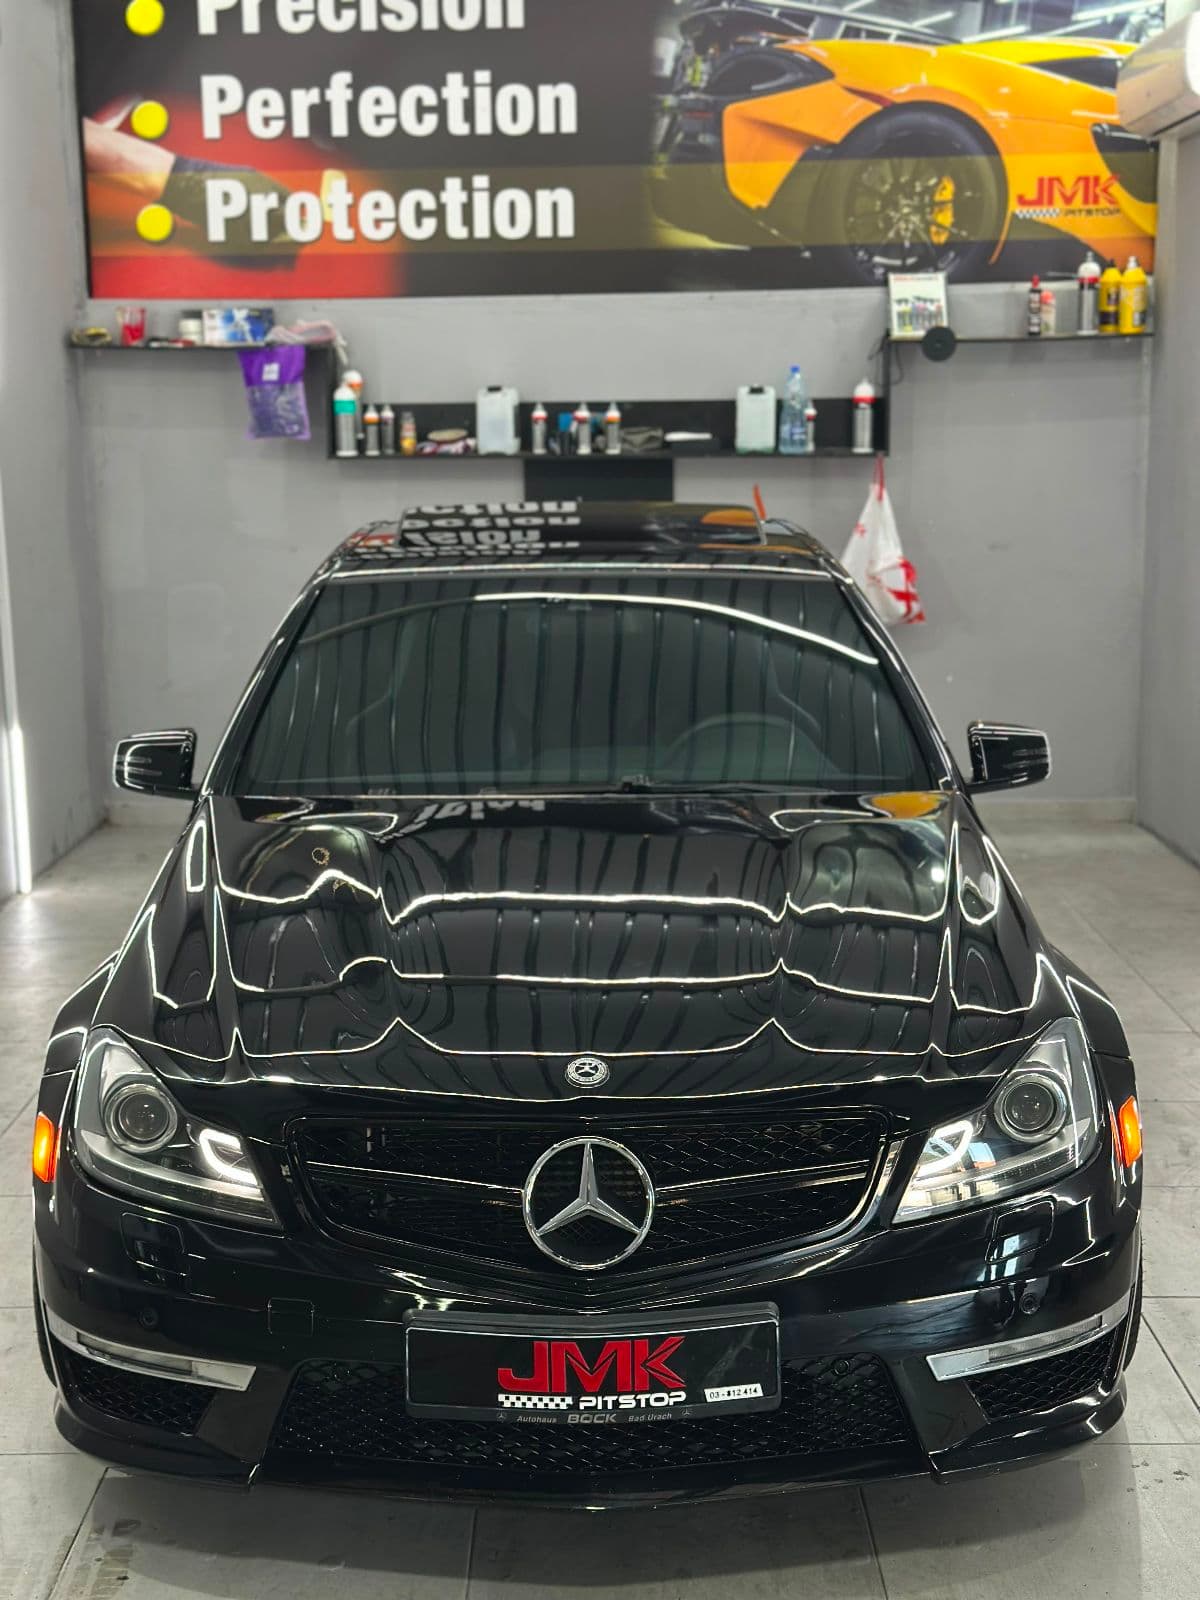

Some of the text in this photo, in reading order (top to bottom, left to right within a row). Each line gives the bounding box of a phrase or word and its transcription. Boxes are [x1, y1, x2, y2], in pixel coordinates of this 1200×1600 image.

[197, 0, 526, 35] Precision
[200, 70, 578, 140] Perfection
[1016, 174, 1120, 206] JMK
[205, 175, 576, 243] Protection
[497, 1335, 688, 1393] JMK
[516, 1412, 673, 1424] Autohaus BOCK Bad Urach
[579, 1391, 687, 1410] PITSTOP
